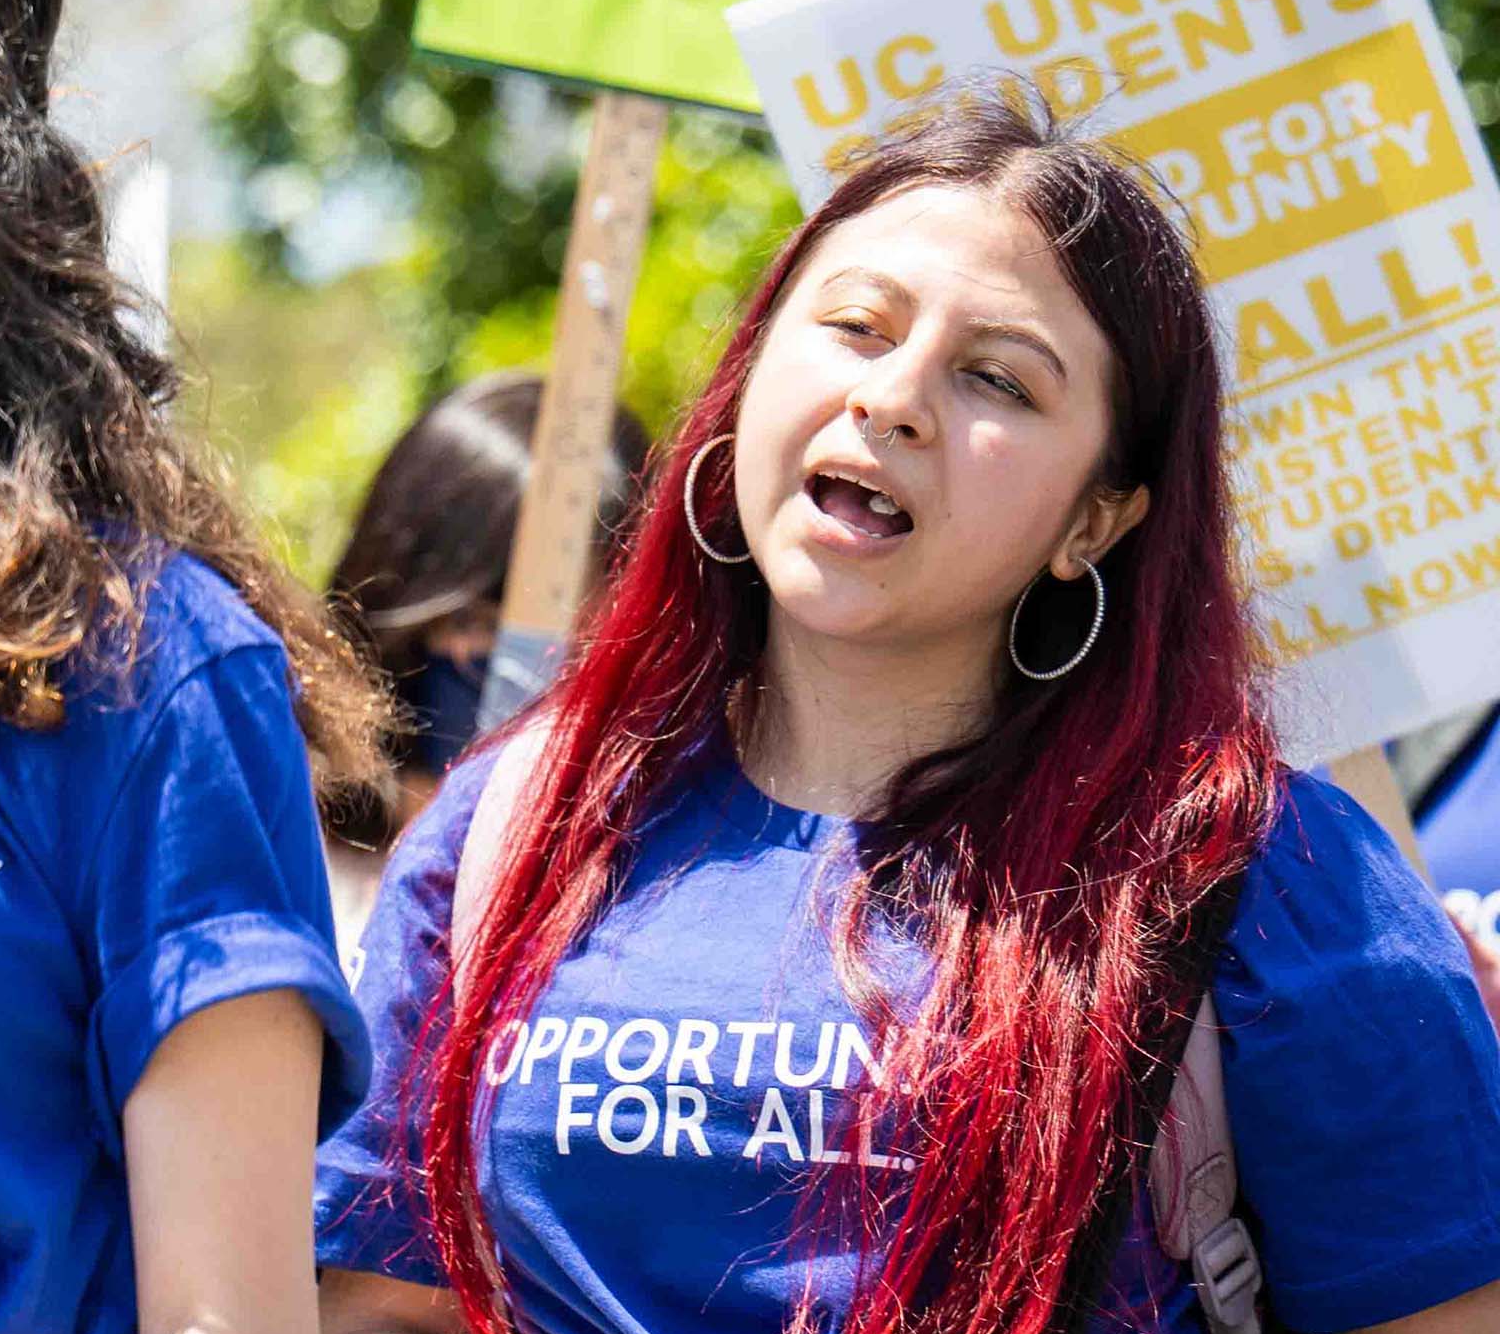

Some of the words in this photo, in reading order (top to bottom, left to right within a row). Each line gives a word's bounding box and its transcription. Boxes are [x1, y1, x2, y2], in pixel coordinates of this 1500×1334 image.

[792, 34, 944, 128] UC
[1218, 78, 1383, 176] FOR
[1236, 219, 1495, 380] ALL!
[1371, 325, 1500, 400] THE
[1250, 397, 1444, 497] ISTEN
[1459, 374, 1500, 415] T
[1332, 470, 1500, 564] DRAK
[1361, 535, 1500, 620] NOW
[485, 1016, 900, 1091] OPPORTUN
[555, 1083, 711, 1158] FOR
[742, 1087, 917, 1172] ALL.
